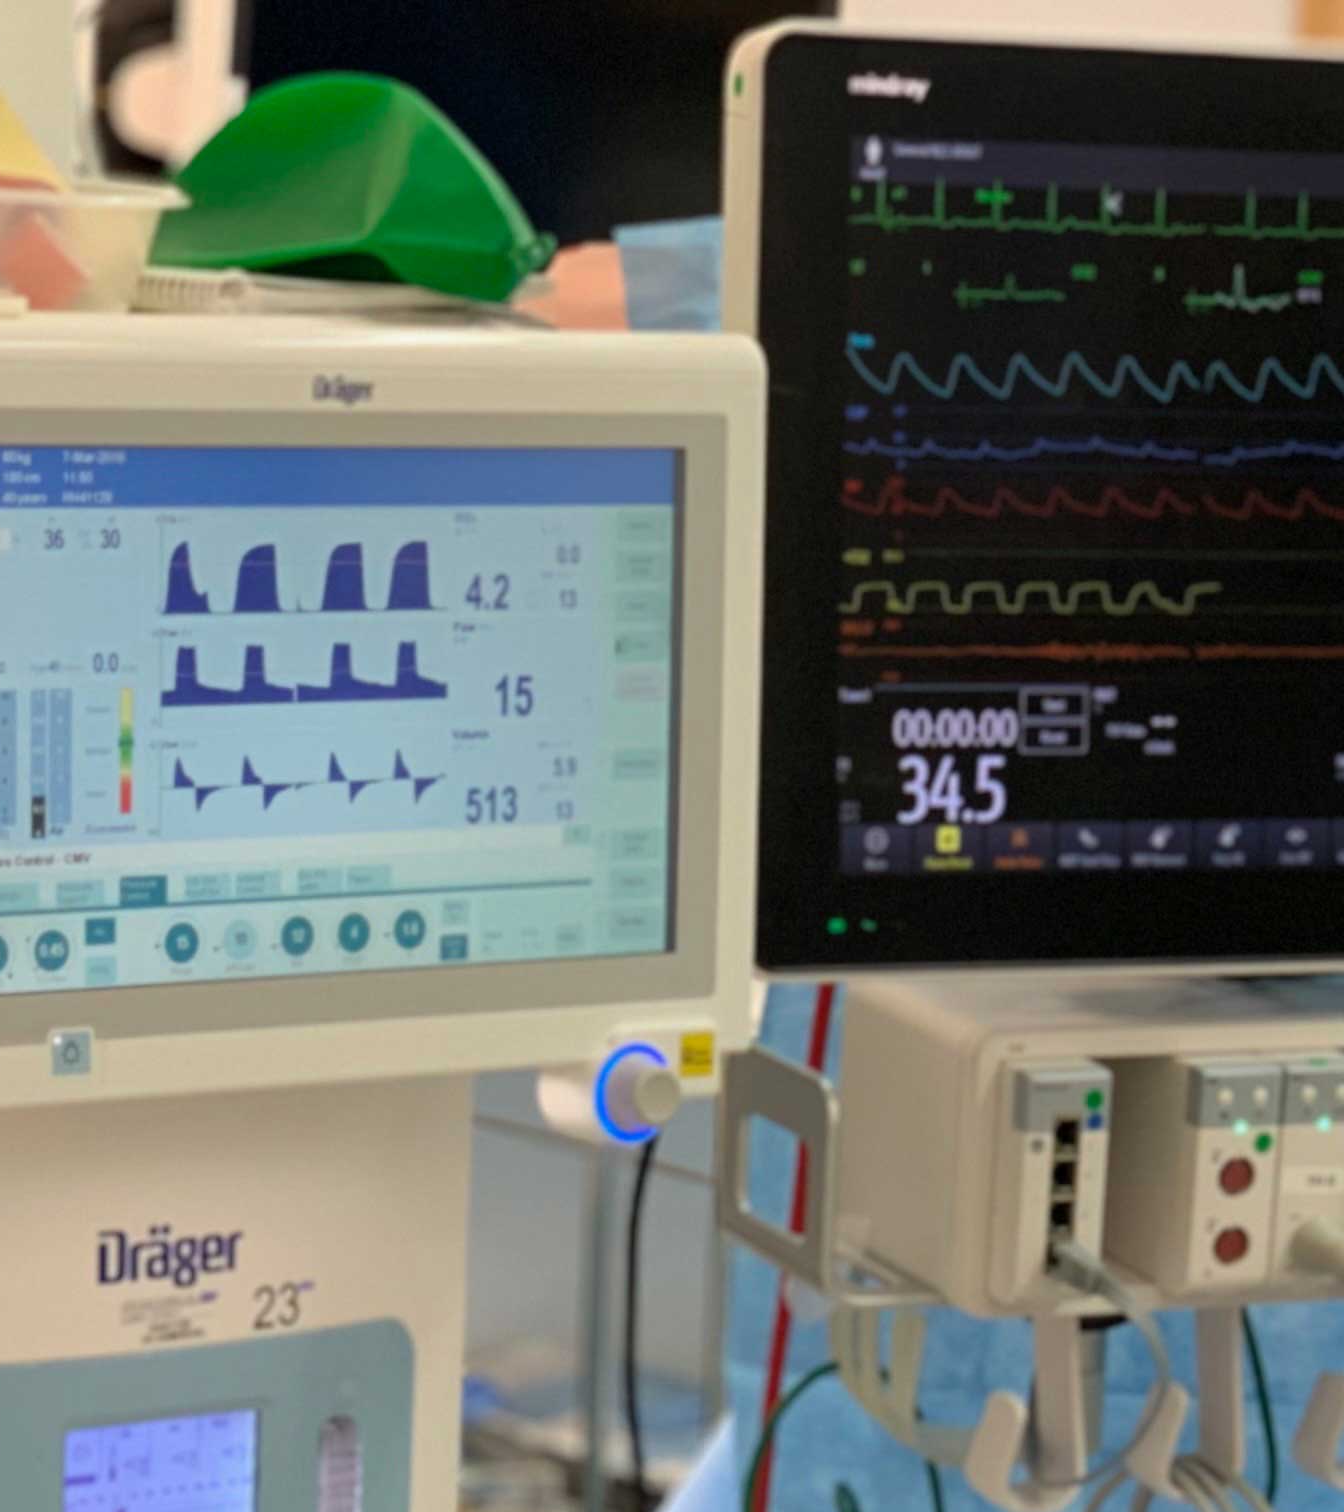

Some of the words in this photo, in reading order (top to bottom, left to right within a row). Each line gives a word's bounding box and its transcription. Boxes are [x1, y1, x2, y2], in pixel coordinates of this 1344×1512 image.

[99, 527, 121, 550] 30
[464, 572, 511, 612] 4.2
[494, 674, 534, 717] 15
[891, 707, 1018, 749] 00:00:00
[465, 785, 519, 824] 513
[897, 754, 1006, 824] 34.5
[97, 1225, 244, 1288] Dräger
[252, 1281, 302, 1330] 23
